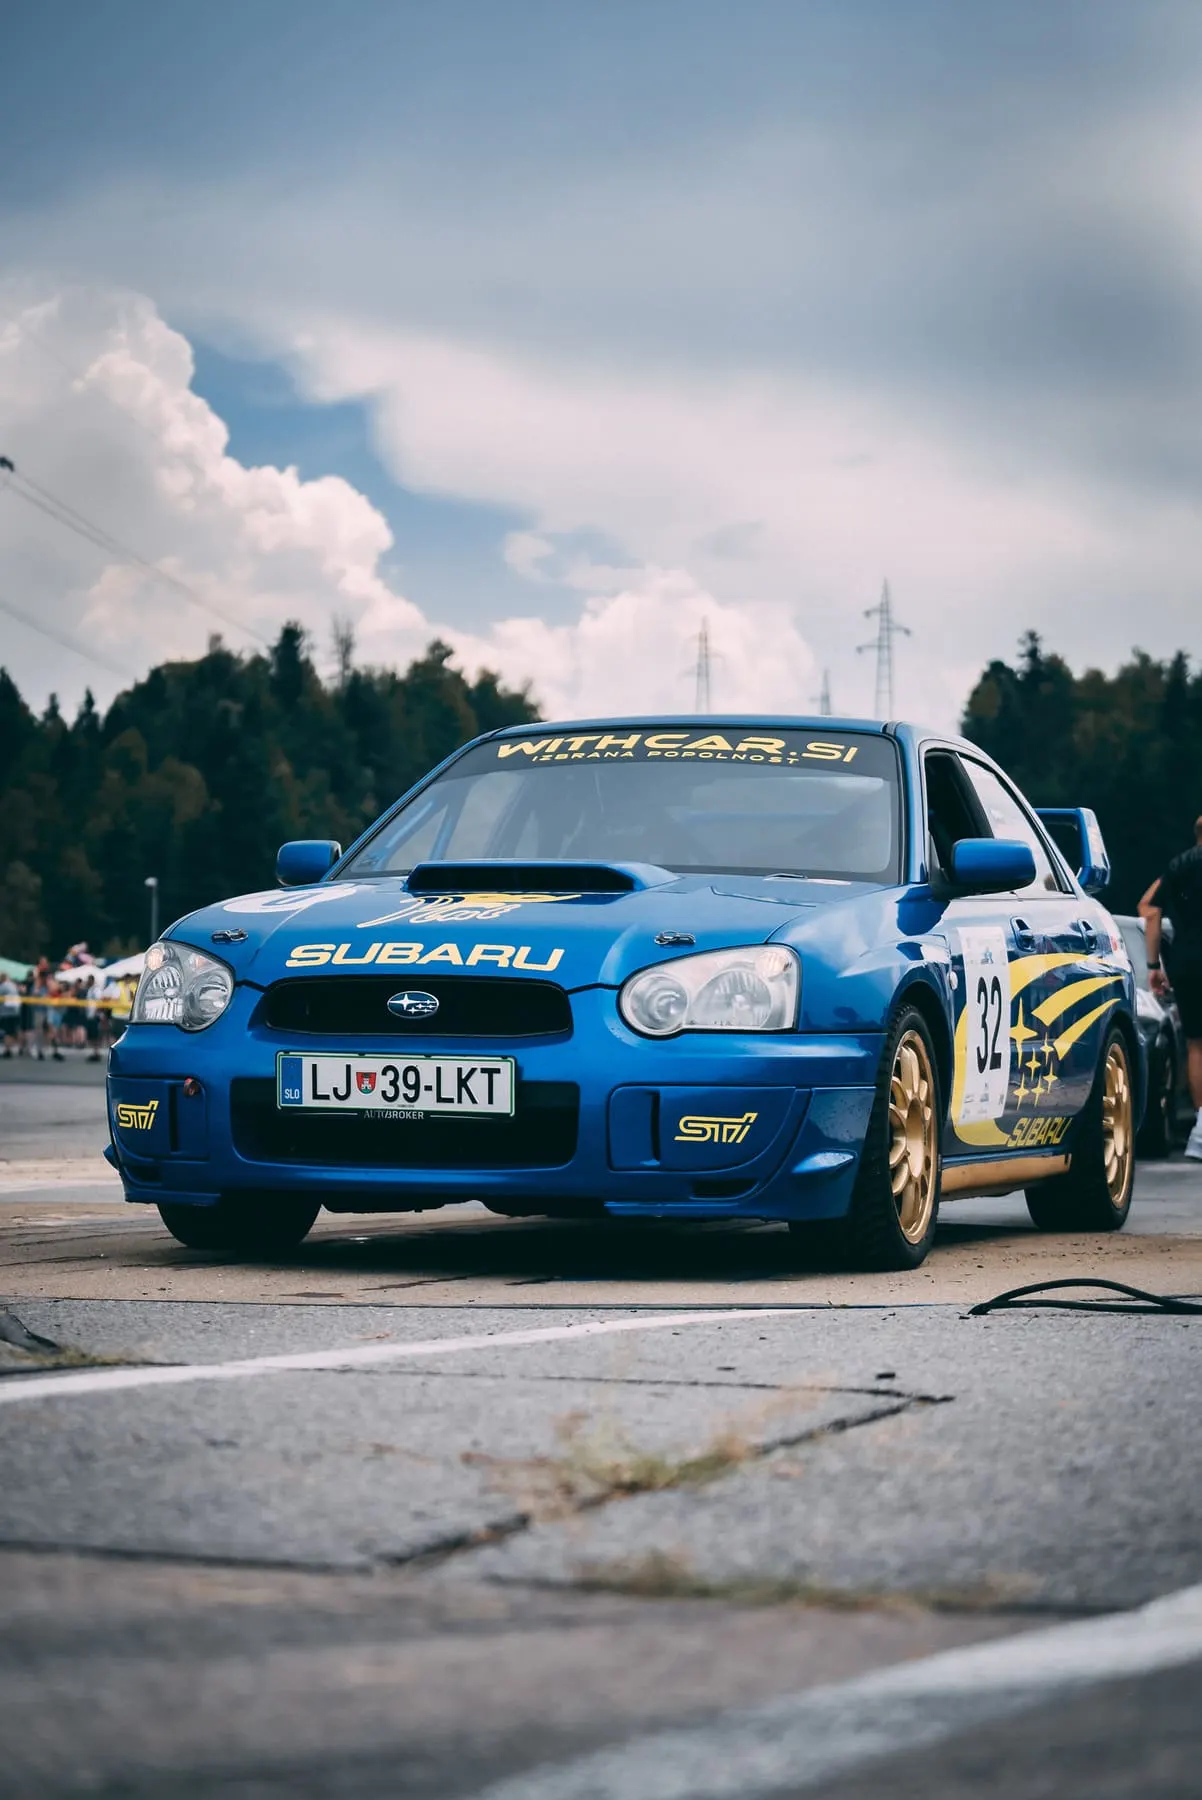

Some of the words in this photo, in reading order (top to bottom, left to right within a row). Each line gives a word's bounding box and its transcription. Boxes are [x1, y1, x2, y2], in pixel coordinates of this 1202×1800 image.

[498, 734, 858, 763] WITHCAR.SI
[531, 751, 634, 762] IZBRANA
[647, 751, 799, 764] POPOLNOST
[285, 943, 565, 971] SUBARU
[976, 975, 1002, 1074] 32
[284, 1088, 300, 1100] SLO
[311, 1063, 352, 1102] LJ
[381, 1064, 501, 1105] 39-LKT
[1007, 1117, 1072, 1147] SUBARU
